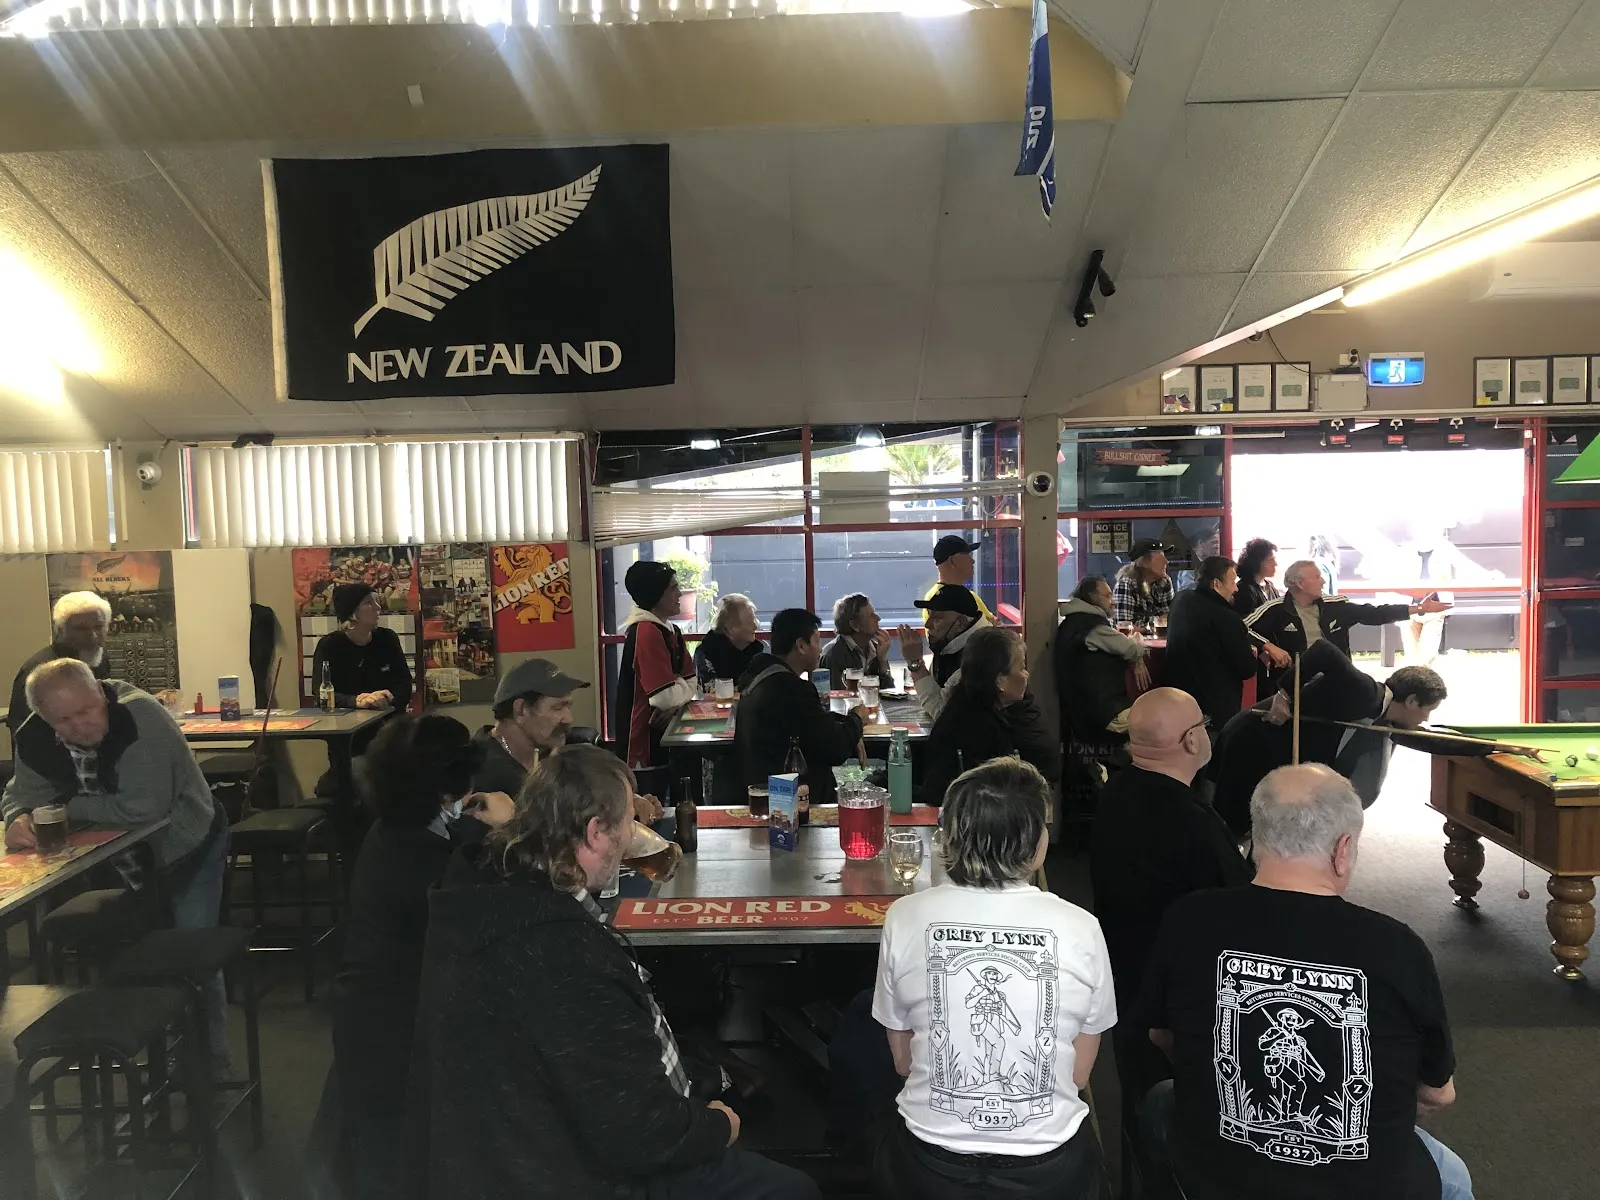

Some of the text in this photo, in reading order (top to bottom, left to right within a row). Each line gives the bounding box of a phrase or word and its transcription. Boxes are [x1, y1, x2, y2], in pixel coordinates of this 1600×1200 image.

[347, 340, 622, 383] NEW ZEALAND
[1104, 451, 1157, 462] BULLSHIT CORNER
[493, 558, 570, 613] LION RED
[632, 900, 831, 915] LION RED
[696, 915, 764, 924] BEER
[933, 928, 1047, 947] GREY LYNN
[952, 953, 976, 968] RETURNED
[1000, 953, 1019, 965] SOCIAL
[1019, 962, 1032, 974] CLUB
[1226, 958, 1355, 991] GREY LYNN
[1245, 991, 1274, 1005] RETURNED
[1274, 990, 1302, 999] SERVICES
[1301, 995, 1323, 1010] SOCIAL
[1322, 1007, 1337, 1021] CLUB
[1043, 1036, 1051, 1047] Z
[1221, 1061, 1233, 1075] N
[1353, 1084, 1364, 1095] Z
[978, 1113, 1009, 1125] 1937
[1284, 1135, 1302, 1143] EST
[1275, 1145, 1311, 1159] 1937
